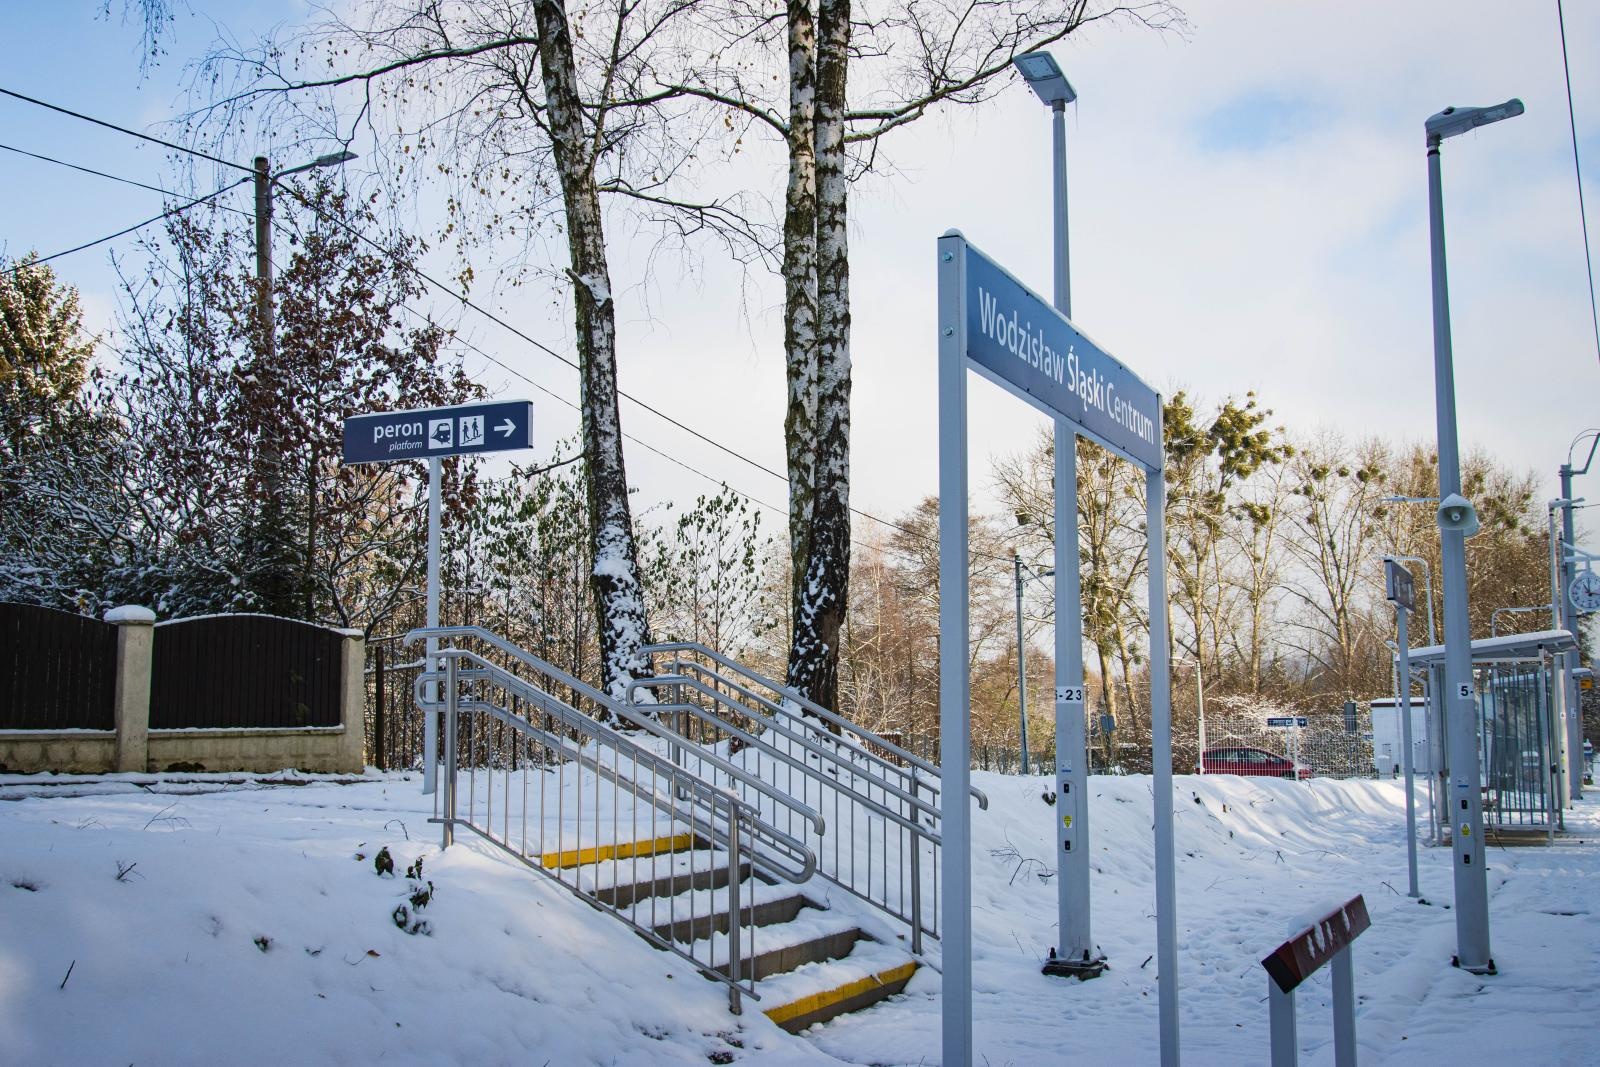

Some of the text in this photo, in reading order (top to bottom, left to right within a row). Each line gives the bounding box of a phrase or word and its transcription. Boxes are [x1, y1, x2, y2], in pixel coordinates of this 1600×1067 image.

[978, 287, 1154, 445] Wodzisław Śląski Centrum
[373, 422, 423, 443] peron
[389, 441, 423, 452] platform
[1055, 689, 1082, 701] -23
